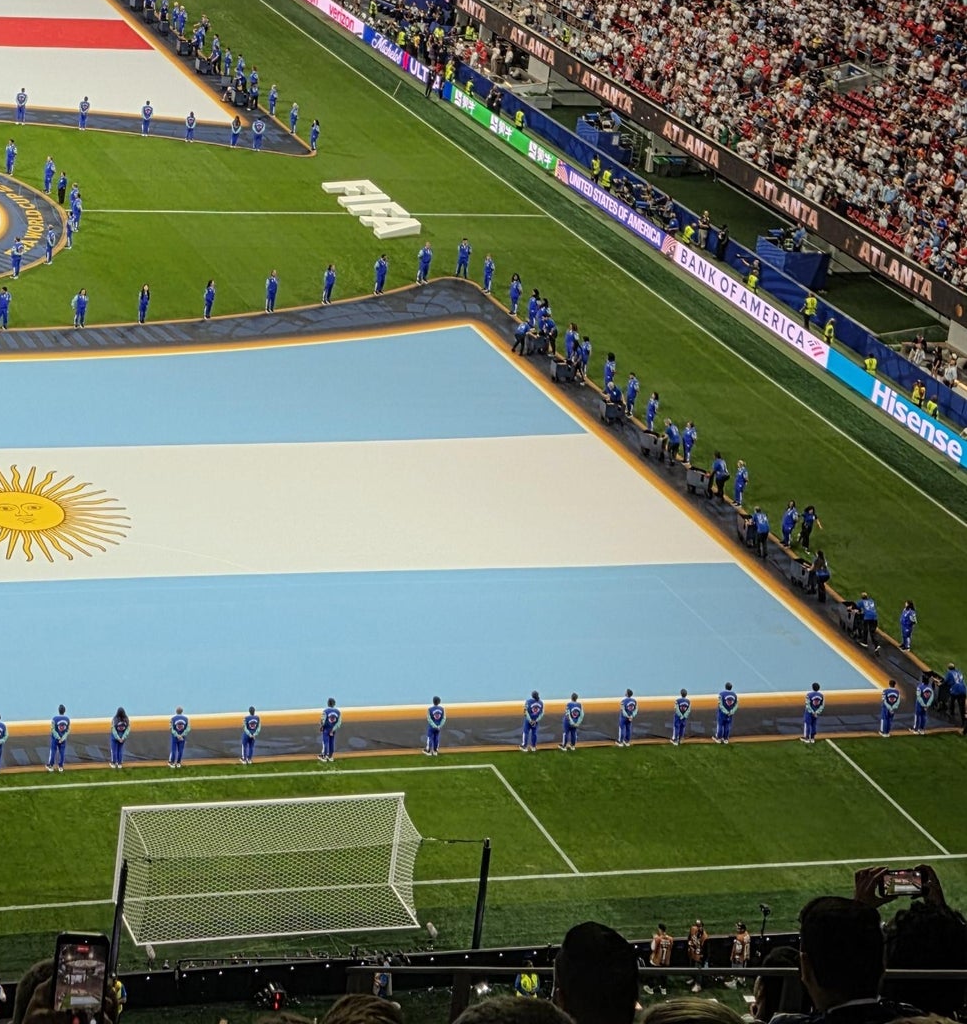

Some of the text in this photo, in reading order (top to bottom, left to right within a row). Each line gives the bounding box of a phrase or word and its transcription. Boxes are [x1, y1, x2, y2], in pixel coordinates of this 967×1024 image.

[329, 3, 355, 33] verizon
[371, 32, 443, 90] Michelob ULTA
[510, 28, 555, 66] ATLANTA
[581, 74, 633, 114] ATLANTA
[662, 120, 719, 169] ATLANTA
[6, 193, 36, 209] CUP
[23, 210, 44, 239] WORLD
[322, 180, 421, 239] FIFA
[569, 170, 661, 246] UNITED STATES OF AMERICA
[753, 176, 818, 230] ATLANTA
[680, 248, 804, 348] BANK OF AMERICA
[859, 241, 933, 301] ATLANTA
[871, 379, 963, 464] Hisense
